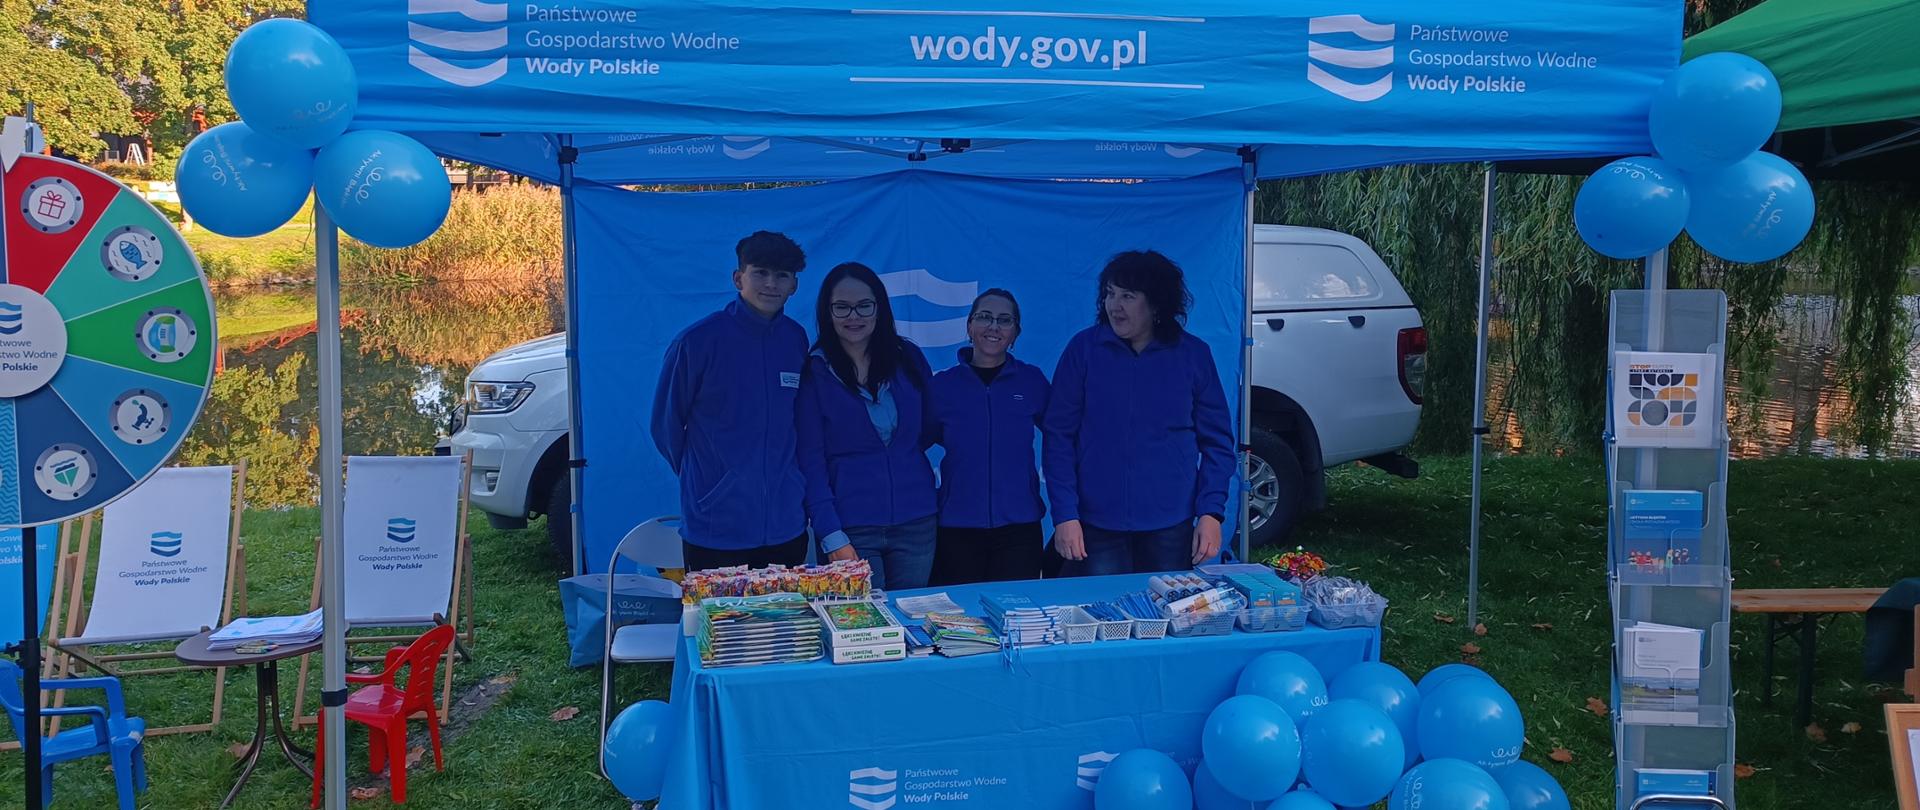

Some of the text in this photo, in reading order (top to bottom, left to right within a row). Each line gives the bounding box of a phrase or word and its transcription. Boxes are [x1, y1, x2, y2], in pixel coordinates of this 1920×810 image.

[525, 4, 637, 23] Państwowe
[1410, 24, 1509, 43] Państwowe
[525, 30, 740, 51] Gospodarstwo Wodne
[909, 26, 1147, 70] wody.gov.pl
[1408, 49, 1598, 69] Gospodarstwo Wodne
[524, 57, 661, 77] Wody Polskie
[1407, 74, 1527, 94] Wody Polskie
[22, 350, 58, 359] Wodne
[2, 362, 39, 371] Polskie
[378, 545, 421, 553] Państwowe
[141, 559, 188, 568] Państwowe
[358, 552, 439, 563] Gospodarstwo Wodne
[118, 565, 208, 579] Gospodarstwo Wodne
[372, 562, 423, 571] Wody Polskie
[134, 576, 190, 586] Wody Polskie
[905, 768, 959, 778] Państwowe
[904, 776, 1008, 791] Gospodarstwo Wodne
[904, 792, 970, 804] Wody Polskie
